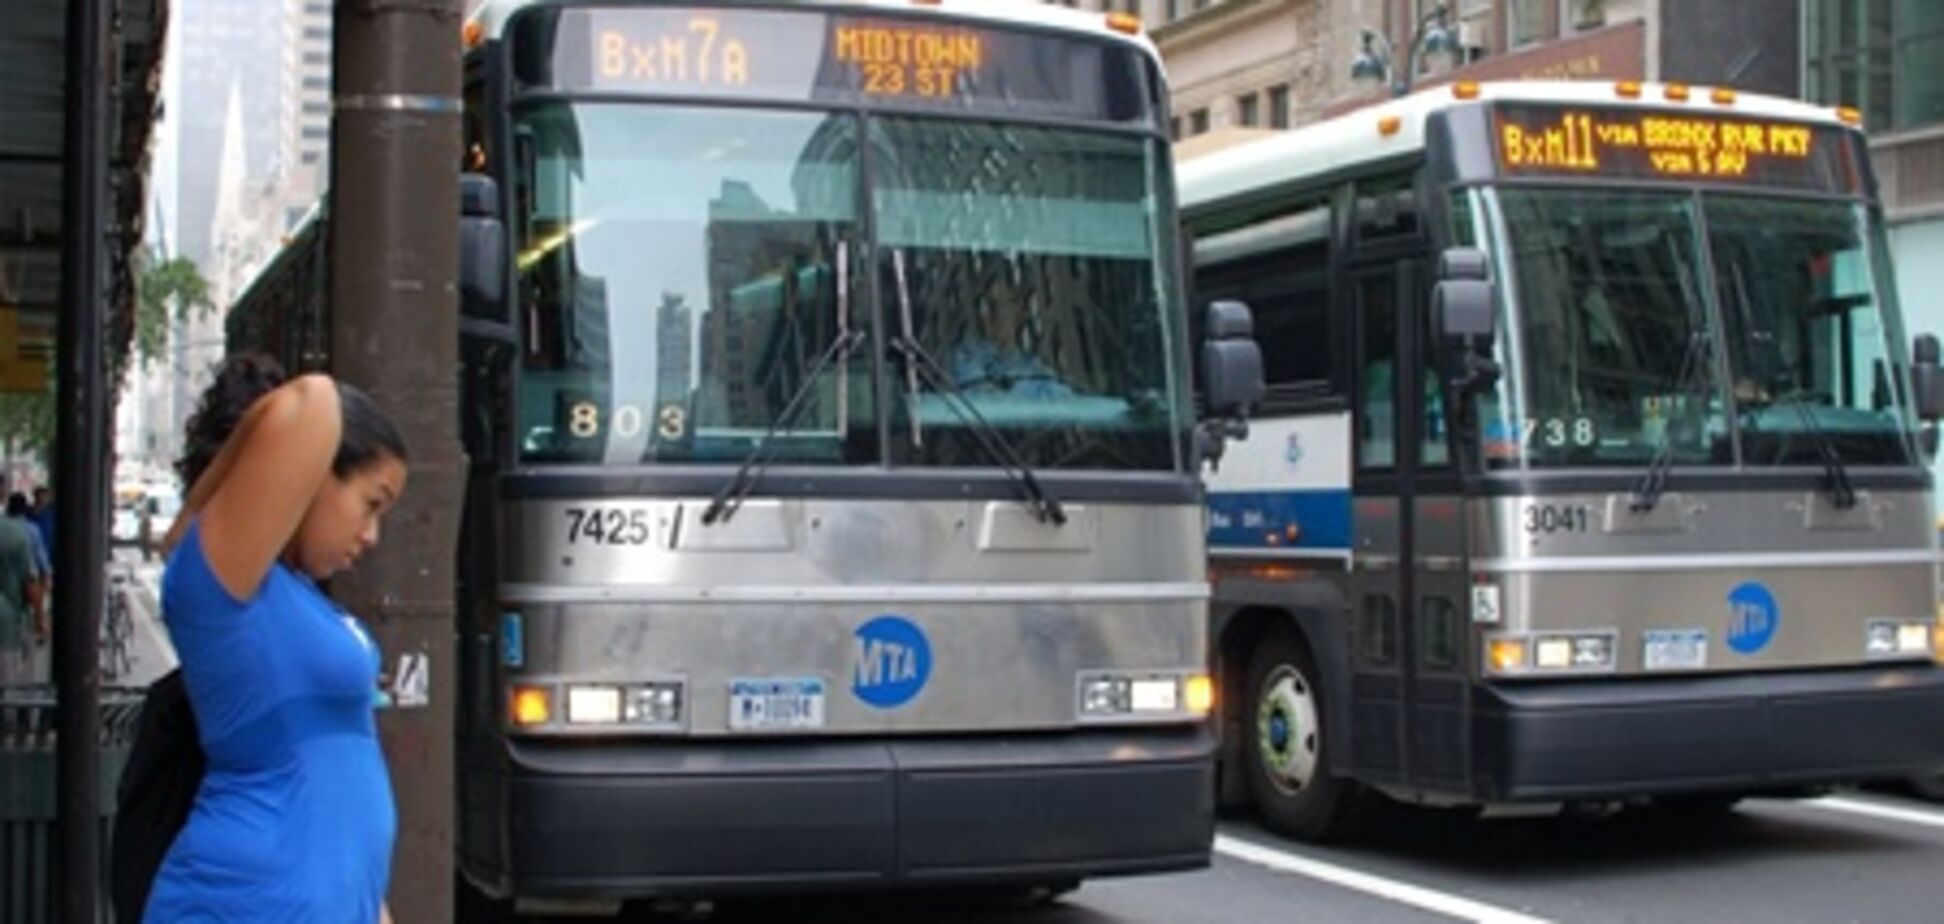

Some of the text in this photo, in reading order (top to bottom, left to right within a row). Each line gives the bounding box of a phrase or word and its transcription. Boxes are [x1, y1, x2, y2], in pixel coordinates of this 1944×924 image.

[599, 19, 748, 86] BxM7A
[837, 27, 980, 67] MIDTOWN
[864, 64, 954, 97] 23 ST
[1504, 114, 1596, 168] BxM11
[565, 508, 649, 546] 7425
[1524, 504, 1588, 533] 3041
[853, 635, 918, 687] MTA
